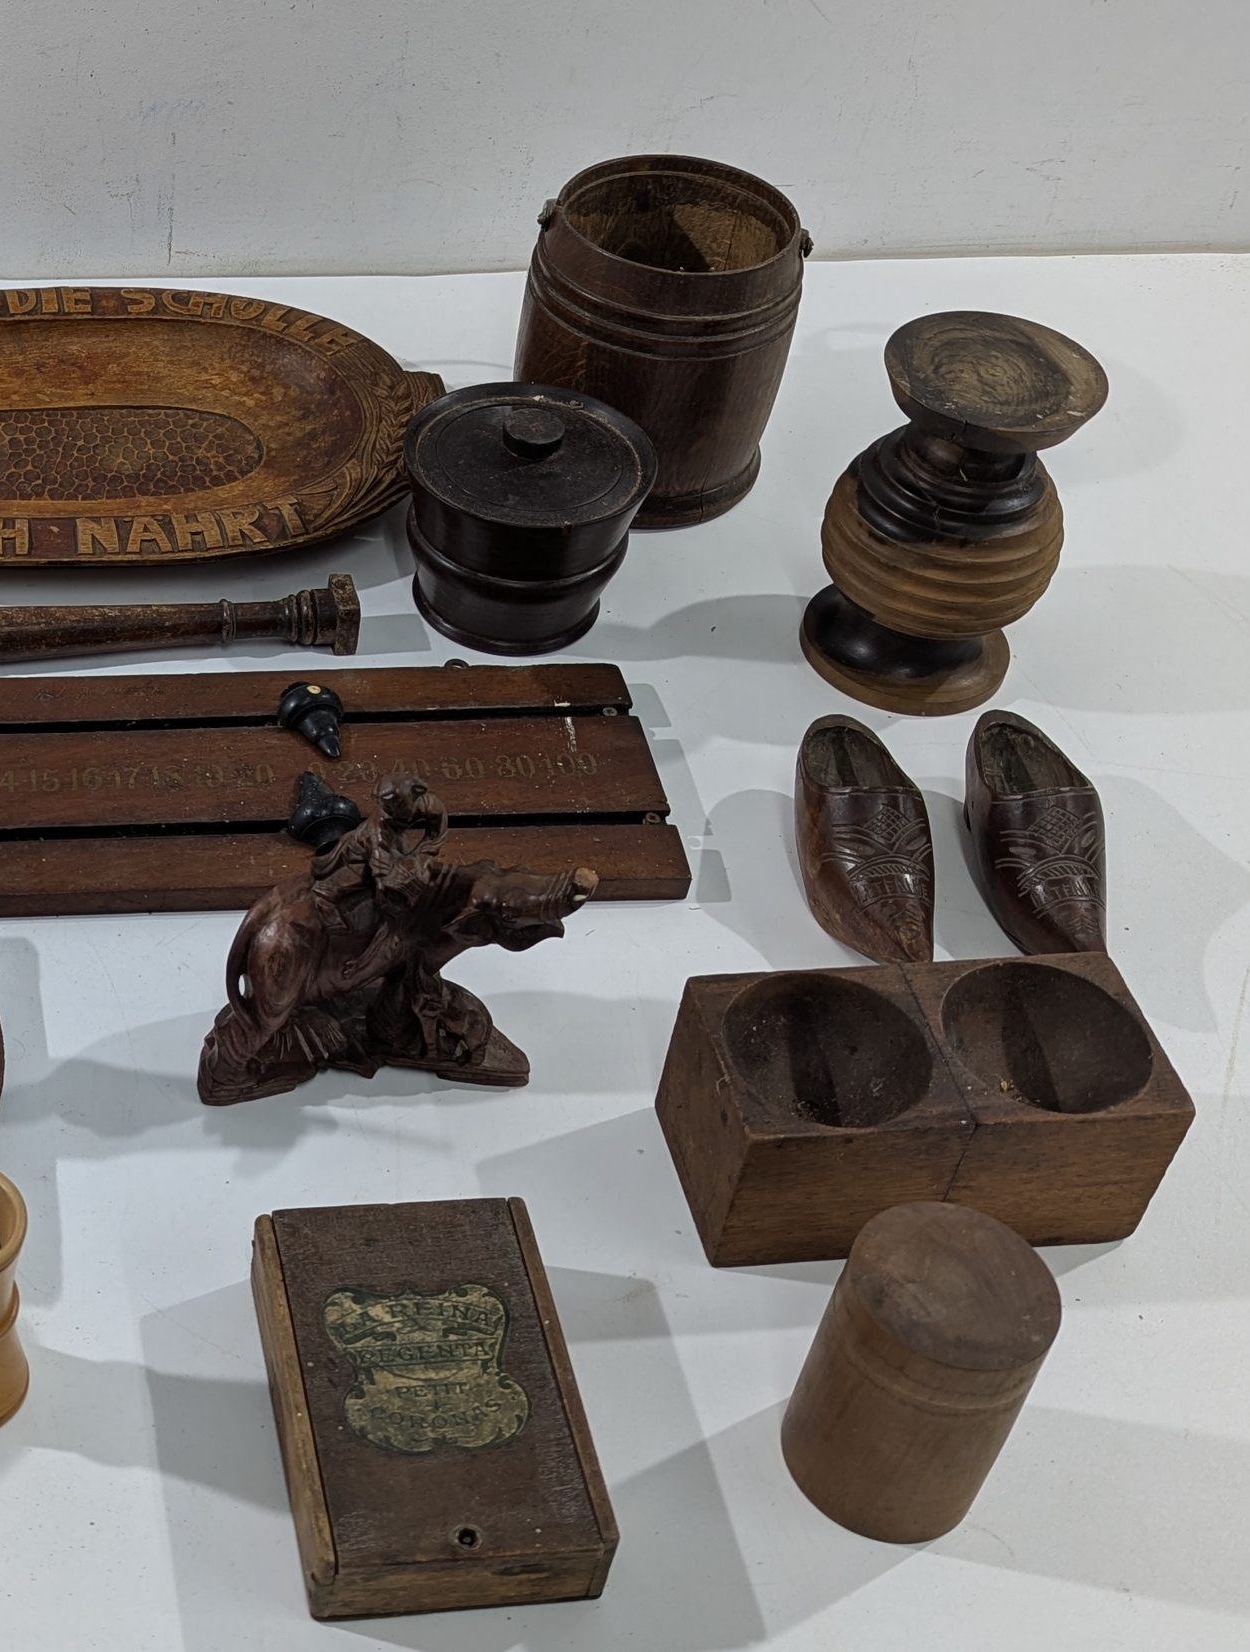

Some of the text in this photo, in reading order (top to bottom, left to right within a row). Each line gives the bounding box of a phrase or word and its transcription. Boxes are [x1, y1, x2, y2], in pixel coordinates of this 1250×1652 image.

[4, 287, 92, 315] DIE
[120, 288, 360, 356] SCHOLLE
[28, 768, 60, 793] 15
[69, 767, 102, 791] 16
[111, 766, 141, 790] 17
[388, 1301, 496, 1329] REINA
[360, 1342, 490, 1364] REGENTA
